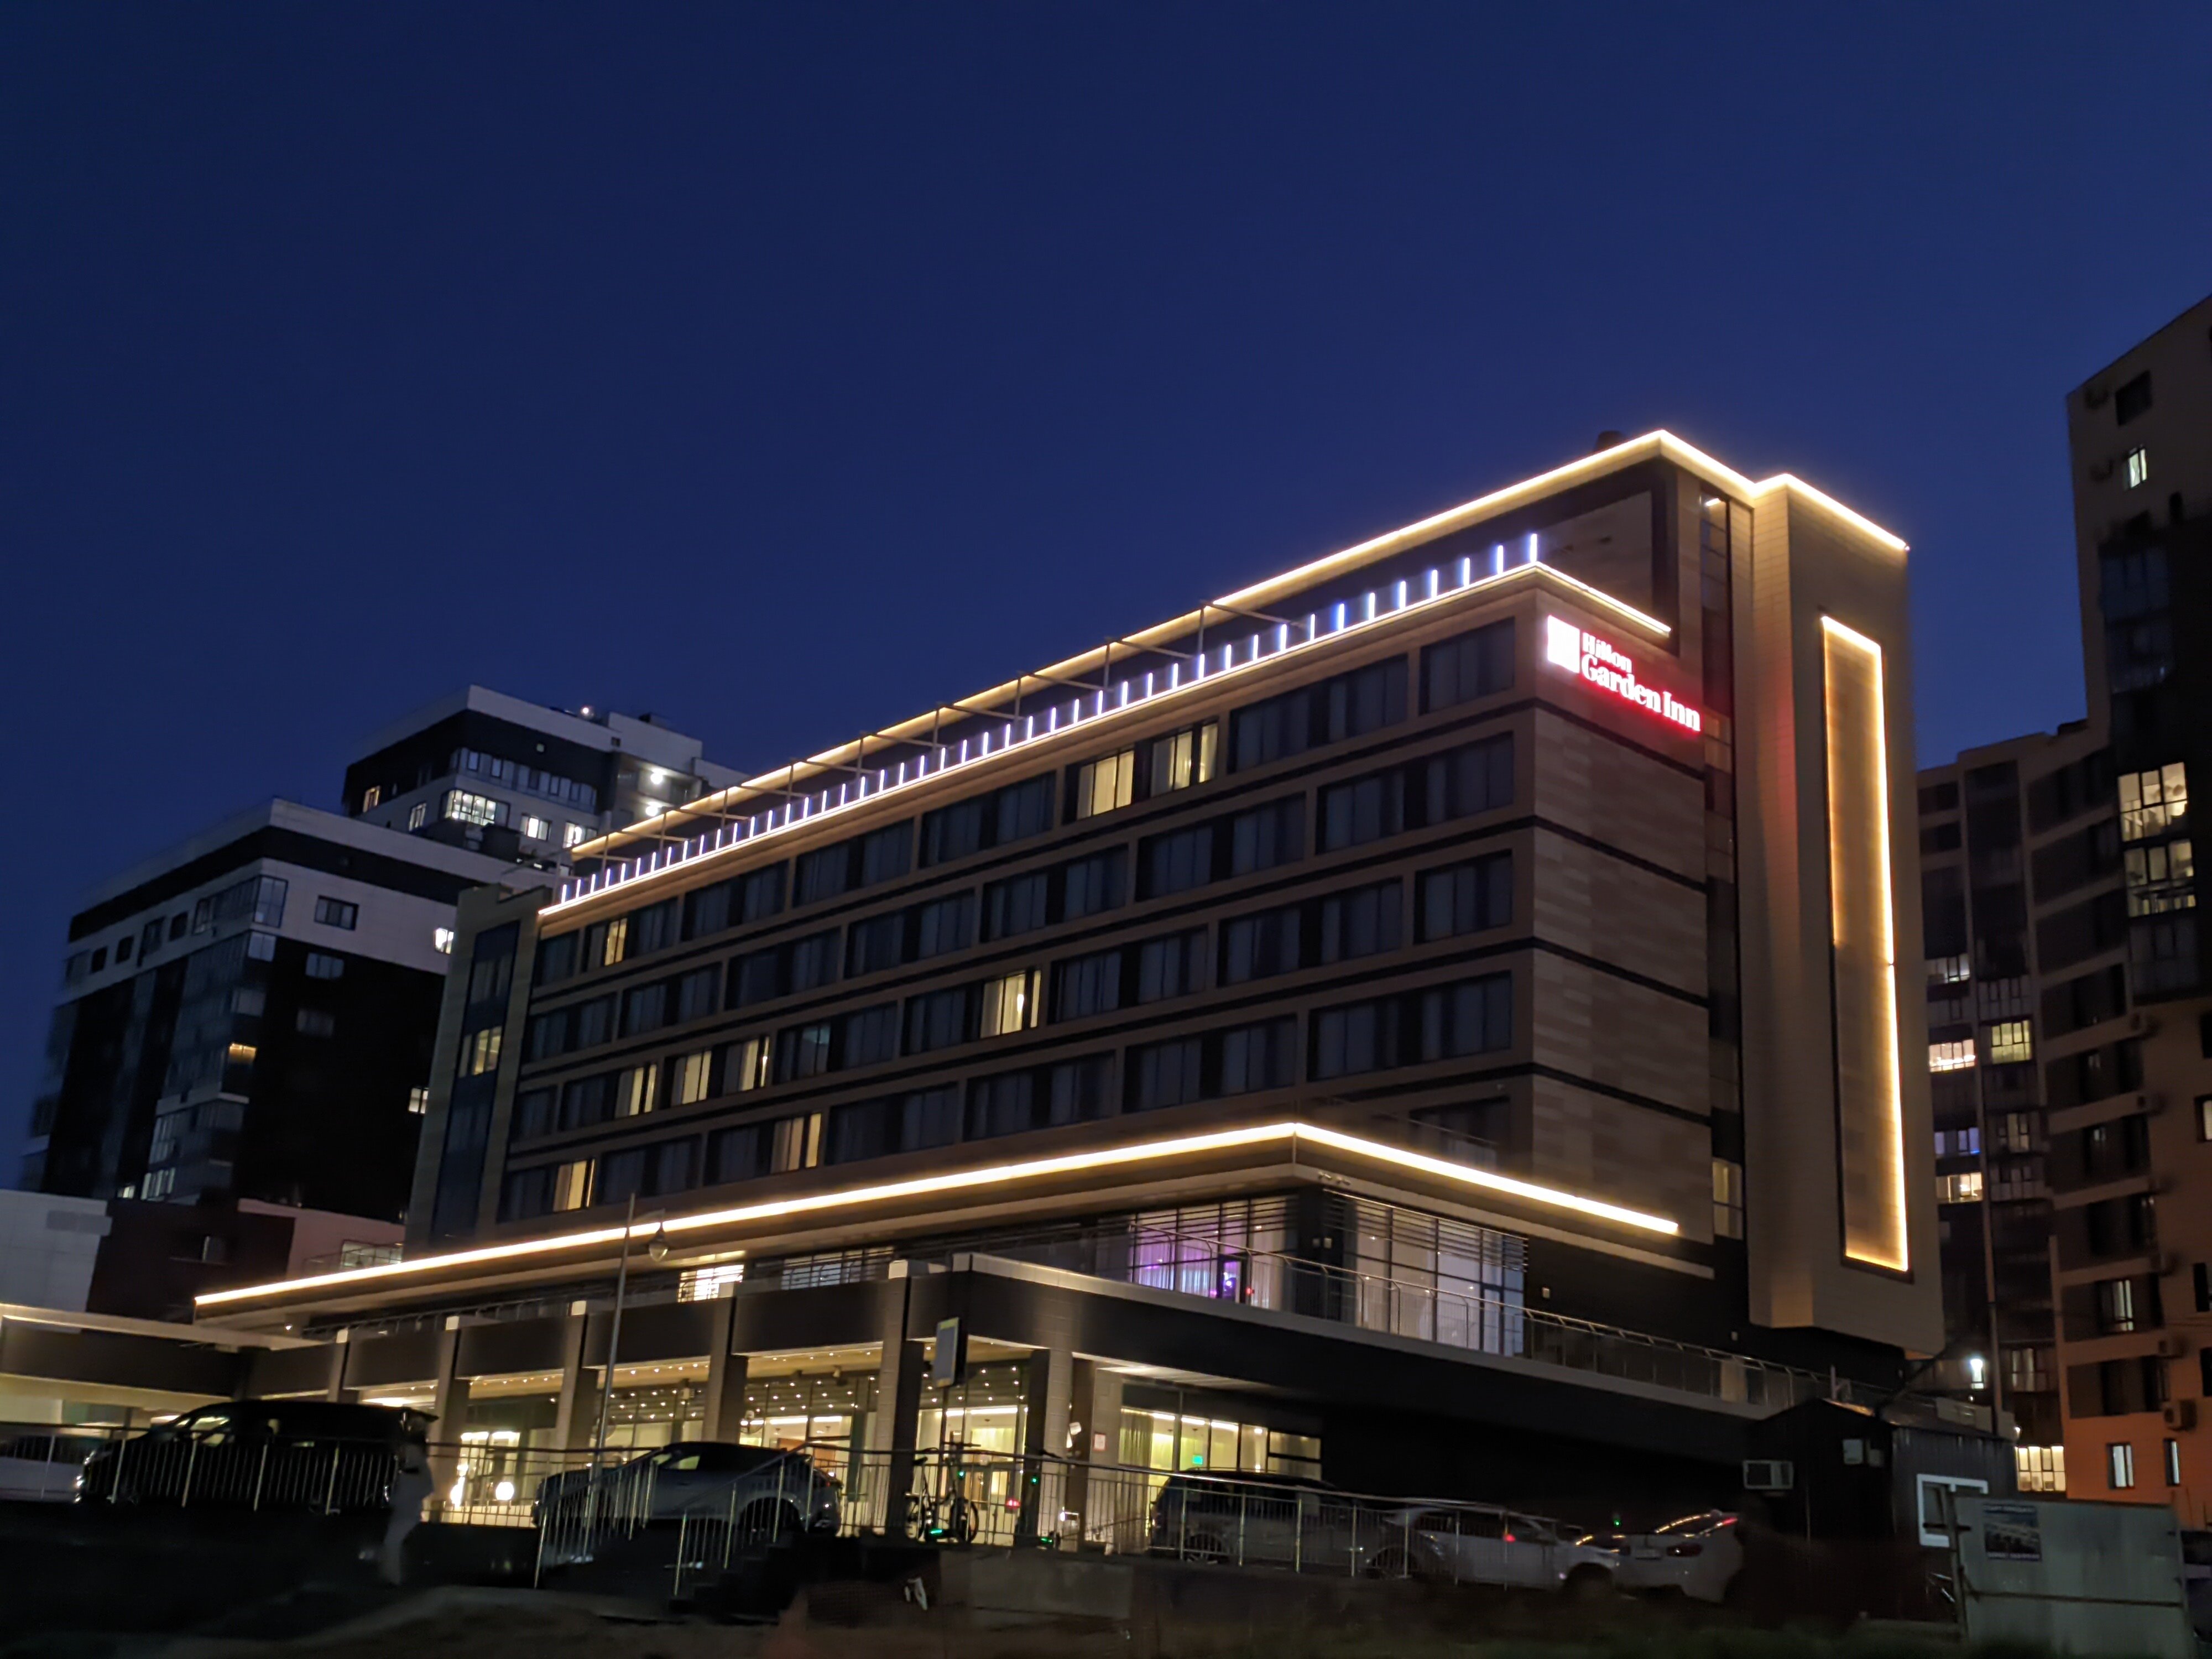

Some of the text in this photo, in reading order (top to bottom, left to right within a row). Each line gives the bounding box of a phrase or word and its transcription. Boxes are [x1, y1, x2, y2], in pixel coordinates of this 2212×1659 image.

[1582, 632, 1632, 674] Hilton
[1582, 654, 1700, 731] Garden Inn
